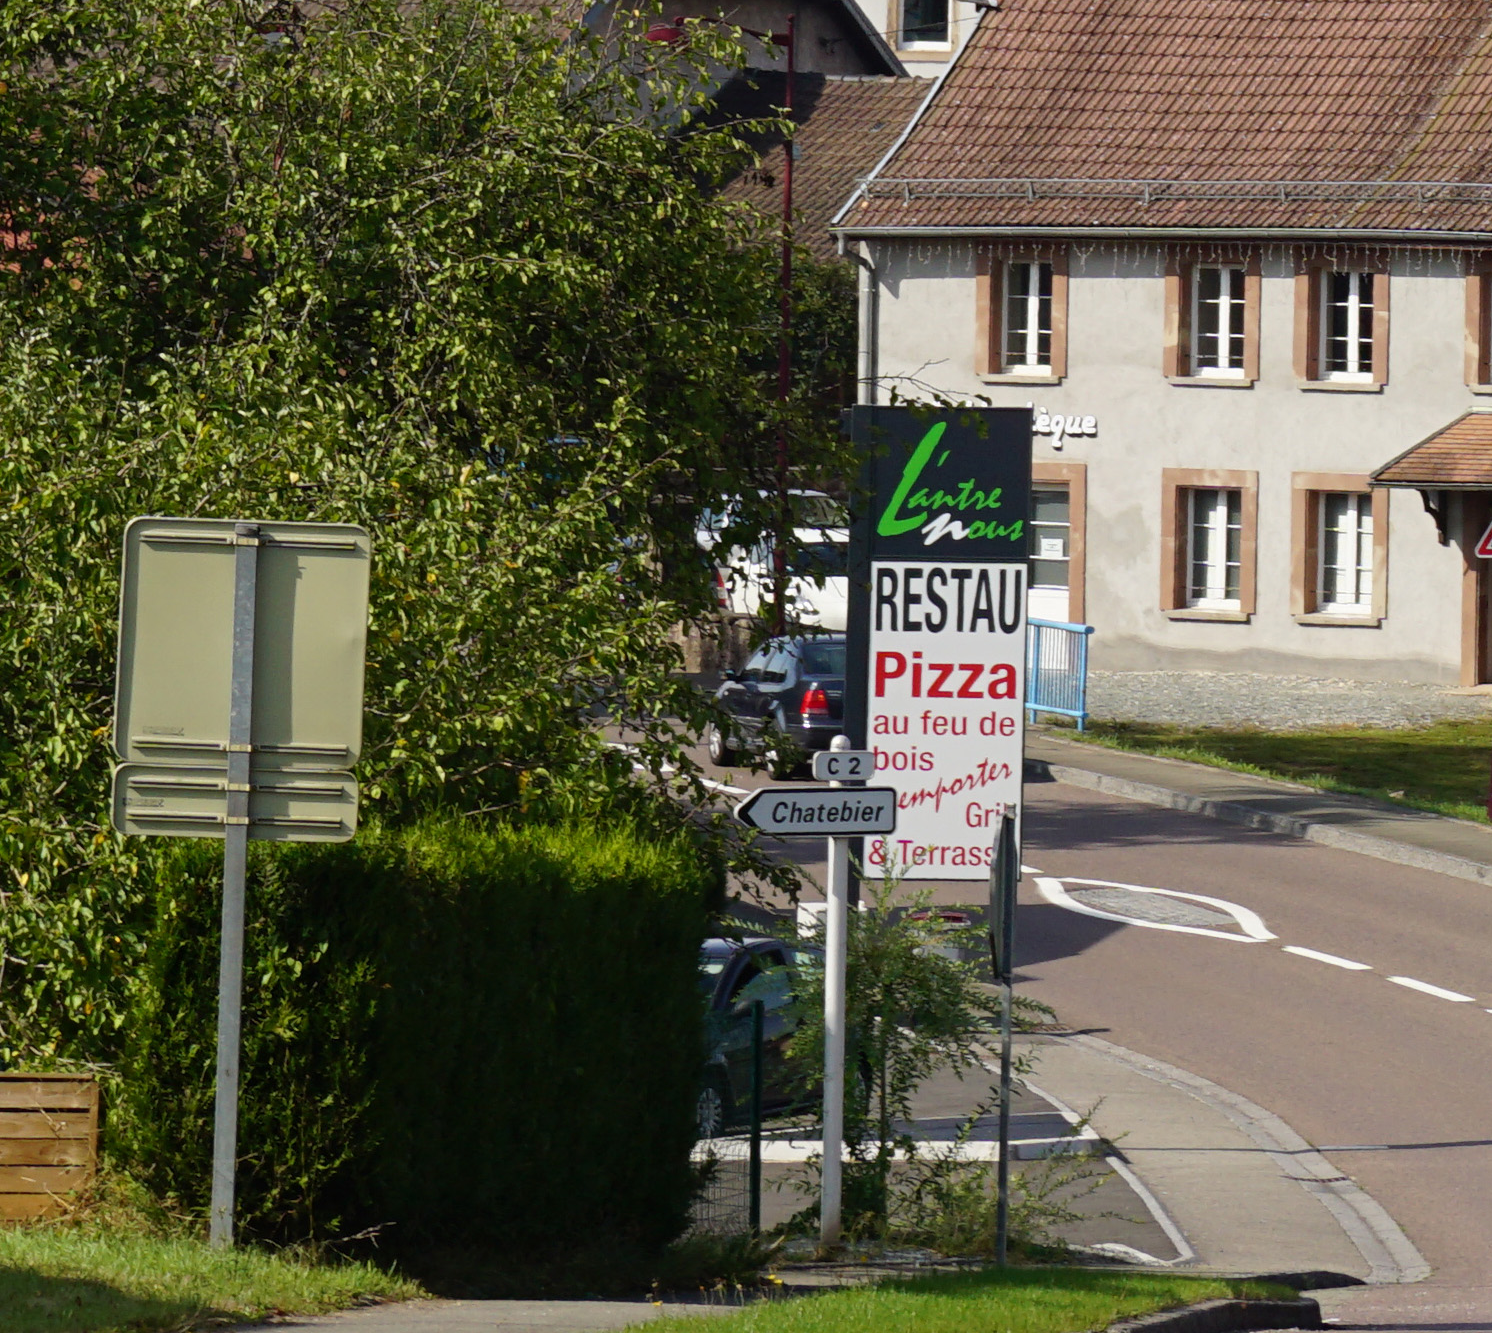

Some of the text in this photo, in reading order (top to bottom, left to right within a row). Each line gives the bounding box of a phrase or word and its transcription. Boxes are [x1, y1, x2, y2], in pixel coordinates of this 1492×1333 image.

[877, 422, 1002, 537] L'antre
[875, 567, 1022, 634] RESTAU
[874, 651, 1017, 700] Pizza
[873, 710, 1016, 736] au feu de
[827, 757, 861, 775] C 2
[873, 745, 935, 772] bois
[897, 757, 1013, 813] emporter
[771, 800, 885, 824] Chatebier
[868, 840, 994, 867] & Terrass
